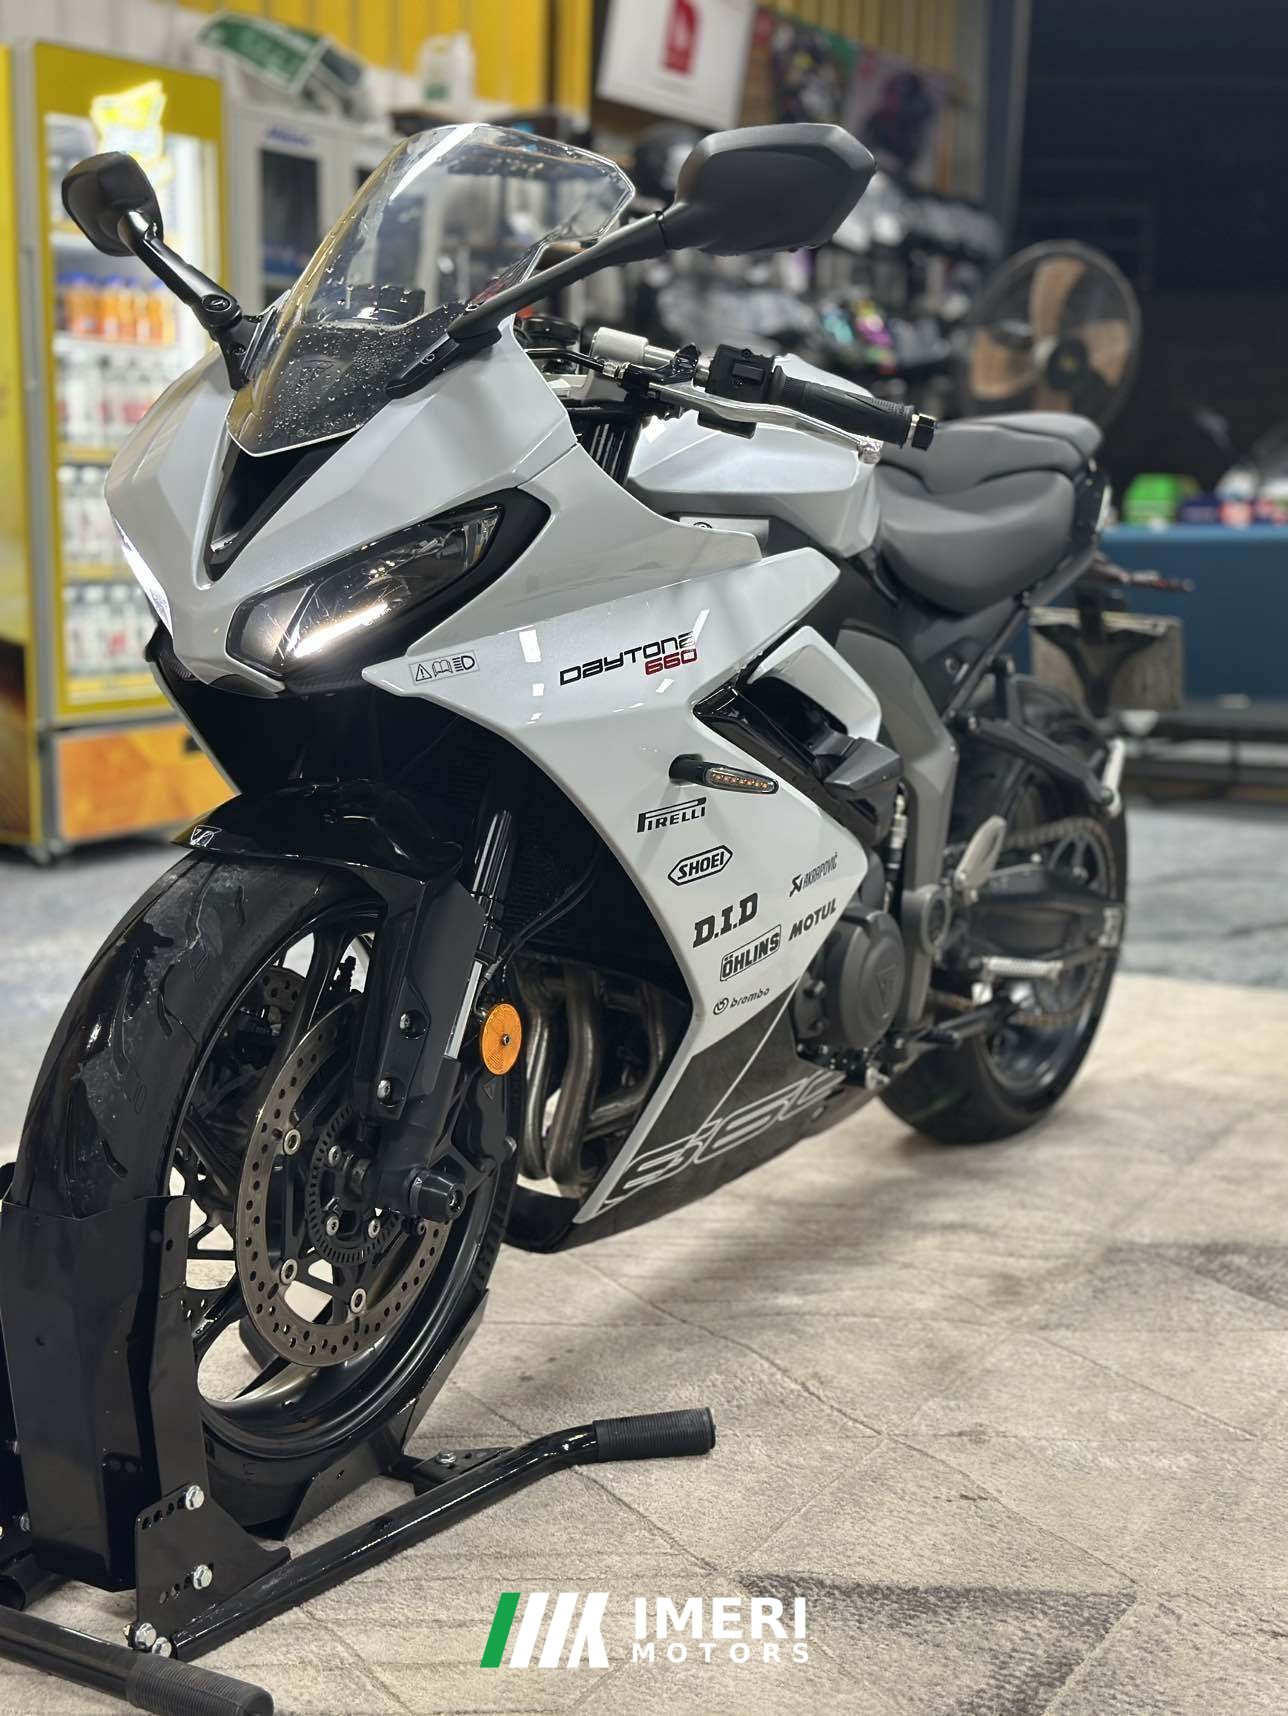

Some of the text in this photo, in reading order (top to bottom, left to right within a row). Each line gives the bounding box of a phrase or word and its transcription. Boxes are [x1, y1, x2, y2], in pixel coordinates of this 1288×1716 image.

[645, 648, 698, 675] 660
[637, 797, 707, 833] PIRELLI
[677, 851, 725, 880] SHOEI
[693, 892, 758, 948] D.I.D
[789, 898, 837, 941] MOTUL
[722, 931, 781, 980] ÖHLINS
[730, 987, 770, 1009] brembo
